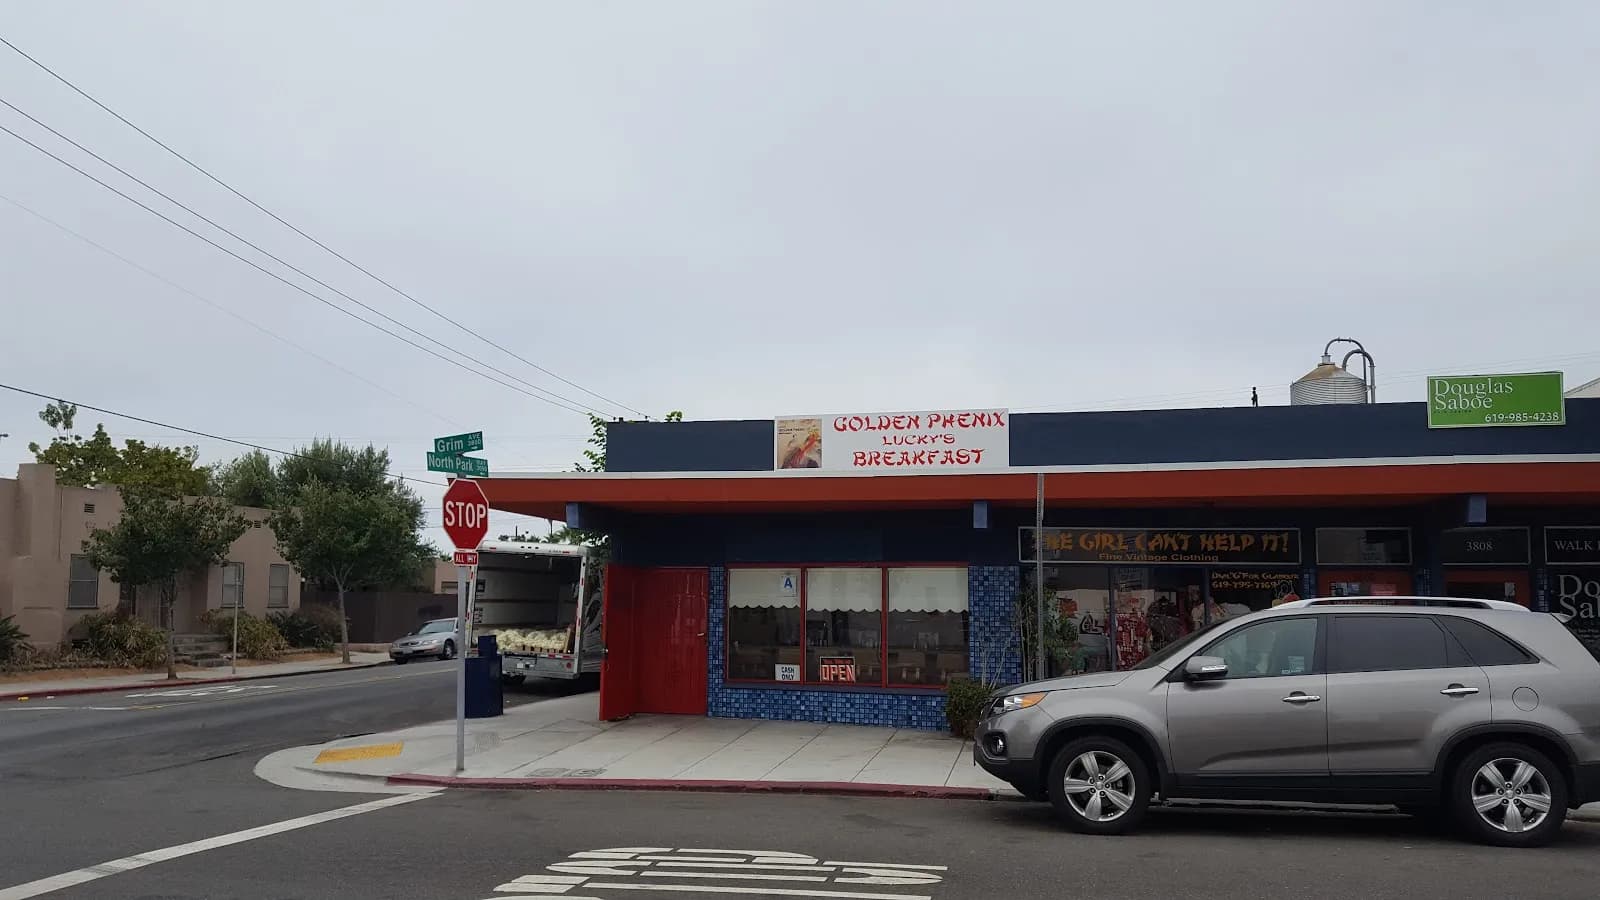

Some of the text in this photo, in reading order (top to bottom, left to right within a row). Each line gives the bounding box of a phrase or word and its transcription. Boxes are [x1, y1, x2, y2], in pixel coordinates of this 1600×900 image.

[1434, 378, 1513, 399] Douglas
[1435, 393, 1493, 410] Saboe
[833, 411, 1006, 432] GOLDEN PHENIX
[1485, 412, 1560, 423] 619-985-4238
[437, 439, 464, 452] Grim
[882, 434, 956, 446] LUCKY'S
[428, 454, 454, 469] North
[456, 457, 474, 472] Park
[853, 449, 985, 467] BREAKFAST
[445, 500, 487, 529] STOP
[1079, 531, 1129, 552] GIRL
[1199, 531, 1256, 552] HELP
[1263, 531, 1290, 553] IT!
[1465, 541, 1493, 552] 3808
[1552, 540, 1593, 551] WALK
[455, 554, 465, 563] ALL
[1099, 553, 1220, 563] Fine Vintage Clothing
[783, 577, 793, 589] A
[781, 673, 795, 681] ONLY
[820, 664, 855, 682] OPEN
